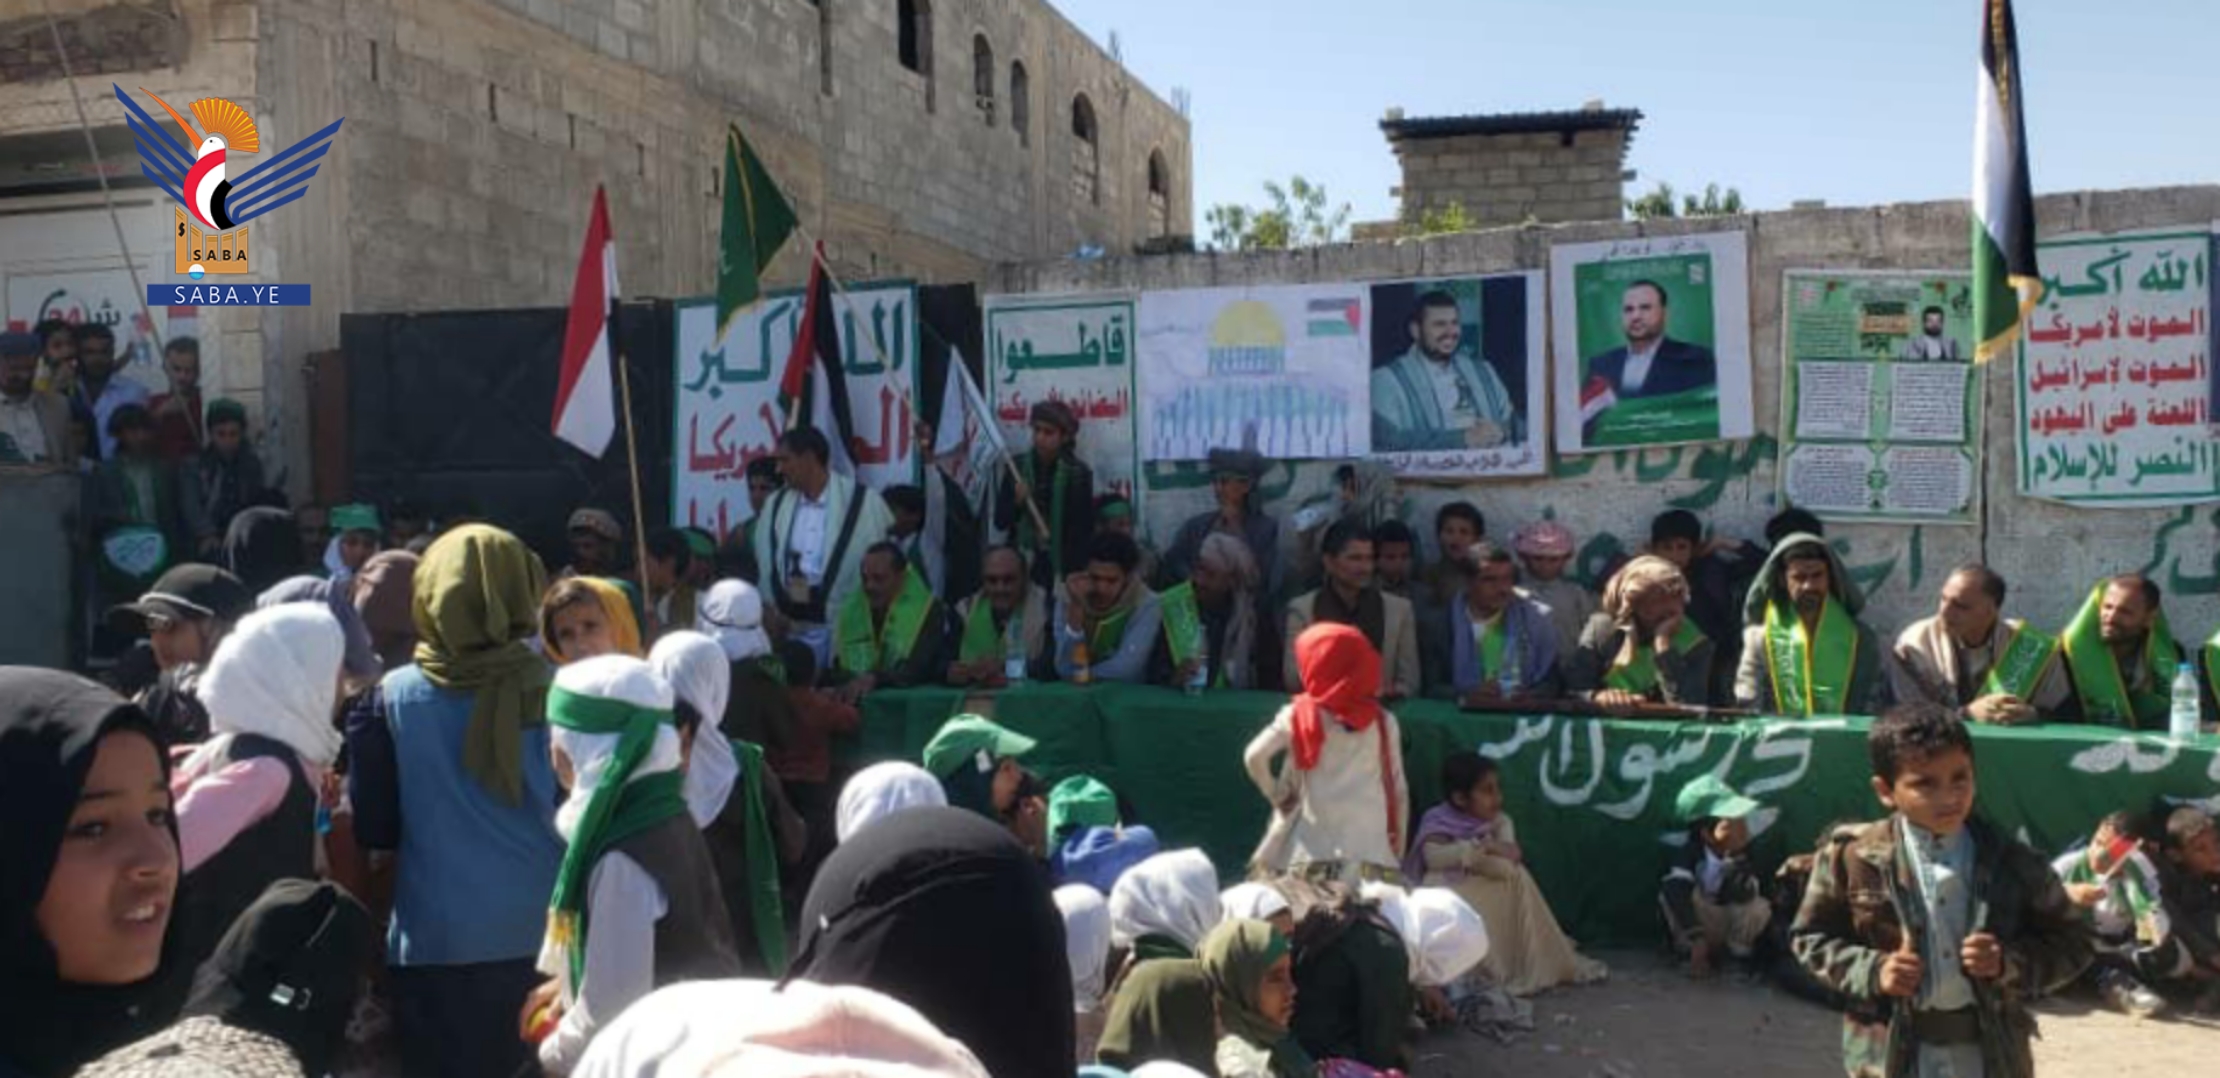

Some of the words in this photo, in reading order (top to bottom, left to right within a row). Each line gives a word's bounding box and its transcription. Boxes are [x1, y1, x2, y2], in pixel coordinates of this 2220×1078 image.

[2036, 246, 2132, 311] أكبر
[2138, 250, 2204, 292] الله
[840, 298, 905, 376] الل
[2029, 305, 2120, 347] لأمريكا
[2128, 307, 2204, 343] الموت
[997, 314, 1125, 384] قاطعوا
[2031, 356, 2120, 394] لإسرائيل
[2128, 353, 2206, 388] الموت
[2031, 402, 2094, 436] اليهود
[2103, 402, 2137, 435] على
[2147, 396, 2206, 426] اللعنة
[2033, 442, 2118, 490] للإسلام
[2128, 436, 2207, 486] النصر
